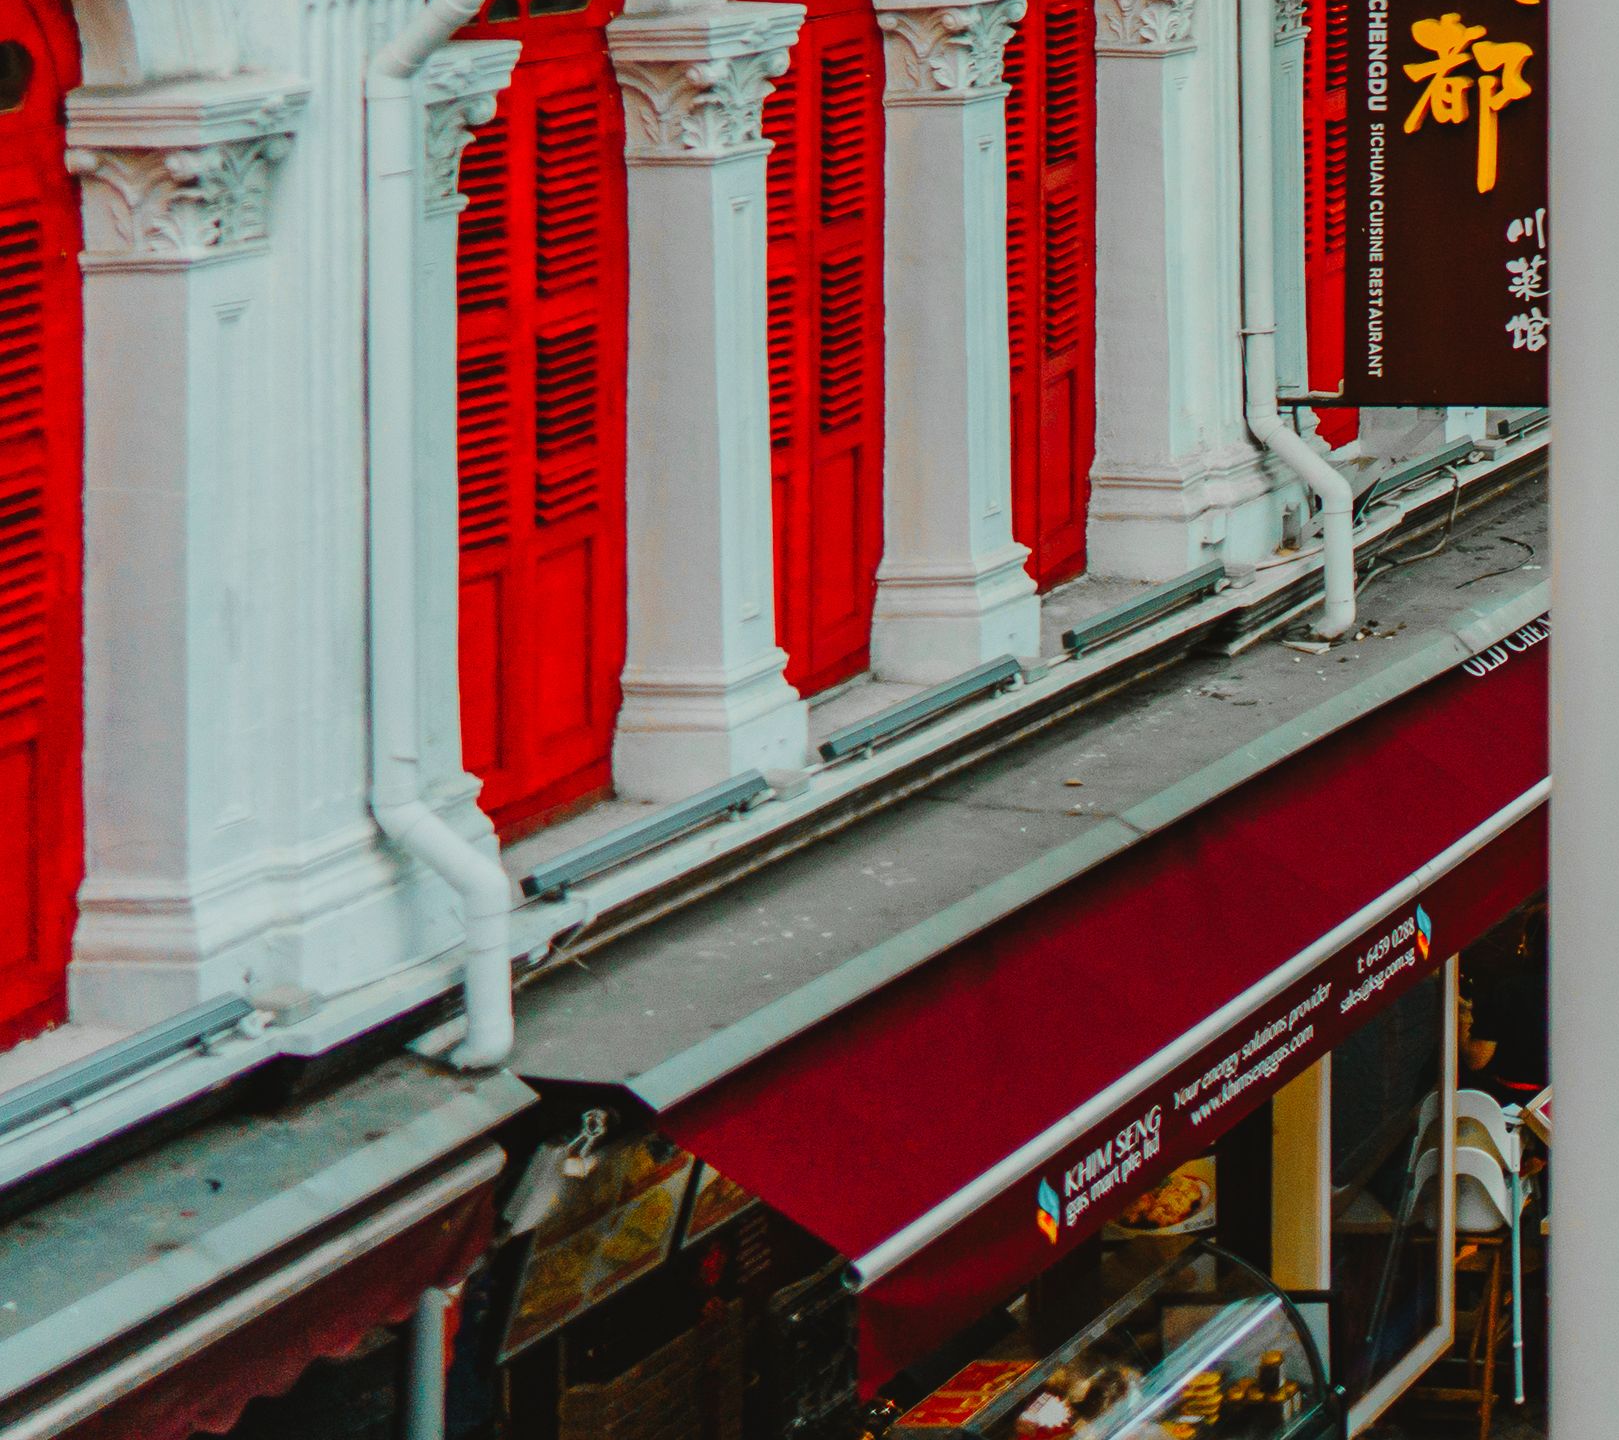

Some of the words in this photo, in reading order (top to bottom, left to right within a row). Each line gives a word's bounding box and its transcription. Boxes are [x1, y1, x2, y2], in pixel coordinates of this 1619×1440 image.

[1369, 122, 1385, 197] SICHUAN
[1369, 198, 1384, 264] CUISINE
[1368, 267, 1384, 378] RESTAURANT
[1506, 208, 1550, 352] 川菜馆
[1173, 1080, 1199, 1110] Your
[1200, 1048, 1240, 1090] energy
[1241, 1019, 1287, 1061] solutions
[1288, 981, 1332, 1031] provider
[1190, 1024, 1315, 1126] www.khimsenggas.com
[1064, 1144, 1112, 1198] KHIM
[1115, 1105, 1162, 1157] SENG
[1065, 1190, 1090, 1227] gas
[1091, 1163, 1121, 1201] mart
